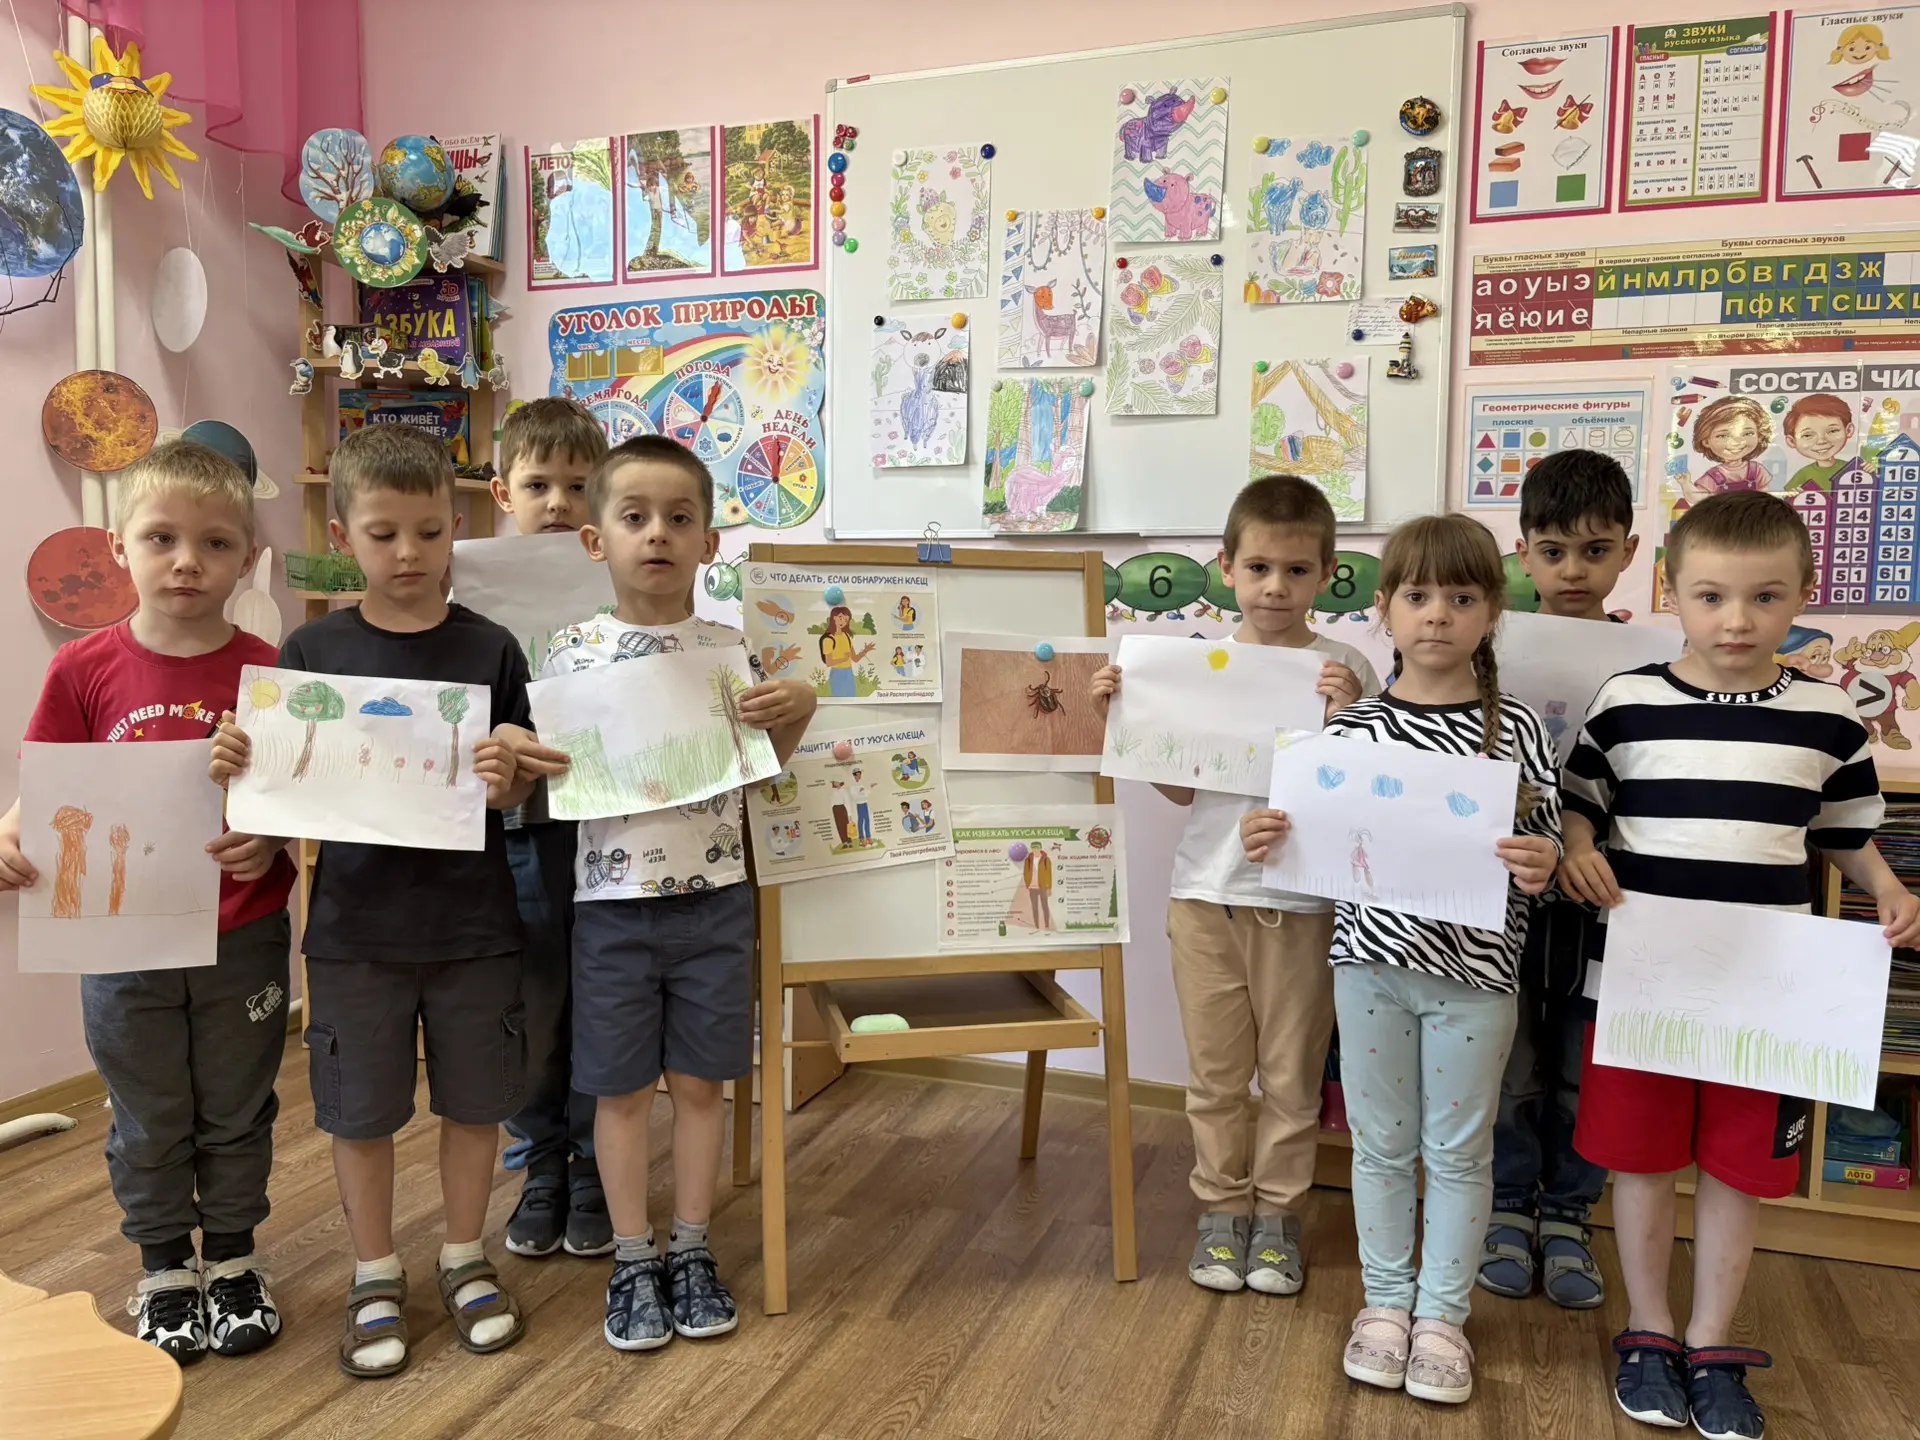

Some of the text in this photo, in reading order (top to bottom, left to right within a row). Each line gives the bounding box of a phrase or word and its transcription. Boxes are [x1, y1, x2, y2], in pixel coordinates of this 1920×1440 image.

[1820, 12, 1904, 26] Гласные звуки
[1682, 24, 1727, 37] ЗВУКИ
[1664, 34, 1741, 48] русского языка
[1501, 42, 1588, 57] Согласные звуки
[1729, 45, 1763, 54] СОГЛАСНЫЕ
[1639, 53, 1665, 61] ГЛАСНЫЕ
[1721, 234, 1846, 248] Буквы согласных звуков
[1482, 250, 1586, 264] Буквы гласных звуков
[1605, 257, 1632, 265] первом
[1633, 256, 1650, 264] ряду
[1682, 252, 1721, 260] согласные
[1475, 278, 1492, 297] а
[1499, 278, 1518, 295] о
[1523, 276, 1542, 300] у
[1546, 274, 1568, 293] ы
[1573, 273, 1591, 291] э
[1597, 267, 1616, 291] й
[1623, 272, 1641, 290] н
[1646, 270, 1670, 288] м
[1673, 269, 1695, 287] л
[1700, 268, 1720, 291] р
[1726, 259, 1747, 284] б
[1782, 263, 1797, 281] г
[1803, 262, 1828, 284] д
[1835, 261, 1852, 279] з
[1858, 260, 1882, 278] ж
[557, 295, 817, 335] УГОЛОК ПРИРОДЫ
[1474, 292, 1906, 330] я ё ю и е п ф к т с ш х
[373, 307, 456, 339] АЗБУКА
[1621, 326, 1688, 336] Непарные звонкие
[1832, 328, 1857, 336] буквы
[675, 360, 732, 380] ПОГОДА
[1738, 368, 1920, 392] СОСТАВ ЧИ
[579, 388, 612, 408] РЕМЯ
[616, 388, 649, 411] ГОДА
[1482, 400, 1631, 413] Геометрические фигуры
[373, 411, 440, 425] КТО ЖИВЁТ
[774, 408, 810, 429] ДЕНЬ
[1492, 416, 1626, 426] плоские объёмные
[762, 421, 817, 450] НЕДЕЛИ
[1899, 449, 1909, 460] 7
[1850, 472, 1863, 484] 6
[1888, 468, 1916, 480] 1 6
[1805, 493, 1816, 505] 5
[1842, 490, 1869, 502] 1 5
[1885, 488, 1914, 499] 2 5
[1811, 512, 1823, 524] 4
[1839, 510, 1868, 522] 2 4
[1884, 507, 1913, 519] 3 4
[1838, 530, 1867, 542] 3 3
[1882, 527, 1911, 539] 4 3
[1836, 550, 1866, 561] 4 2
[1881, 547, 1910, 559] 5 2
[770, 572, 928, 586] ЧТО ДЕЛАТЬ, ЕСЛИ ОБНАРУЖЕН КЛЕЩ
[1836, 569, 1862, 581] 5 1
[1879, 567, 1906, 579] 6 1
[1149, 565, 1173, 598] 6
[1330, 563, 1356, 599] 8
[1833, 589, 1863, 601] 6 0
[1879, 588, 1907, 599] 7 0
[1706, 668, 1793, 704] SURF VIBES
[889, 691, 935, 699] Роспотребнадзор
[107, 703, 216, 743] JUST NEED MORE
[854, 737, 865, 746] ОТ
[867, 734, 895, 745] УКУСА
[896, 729, 926, 741] КЛЕЩА
[955, 828, 1065, 838] КАК ИЗБЕЖАТЬ УКУСА КЛЕЩА
[1847, 1170, 1872, 1180] ЛОТО
